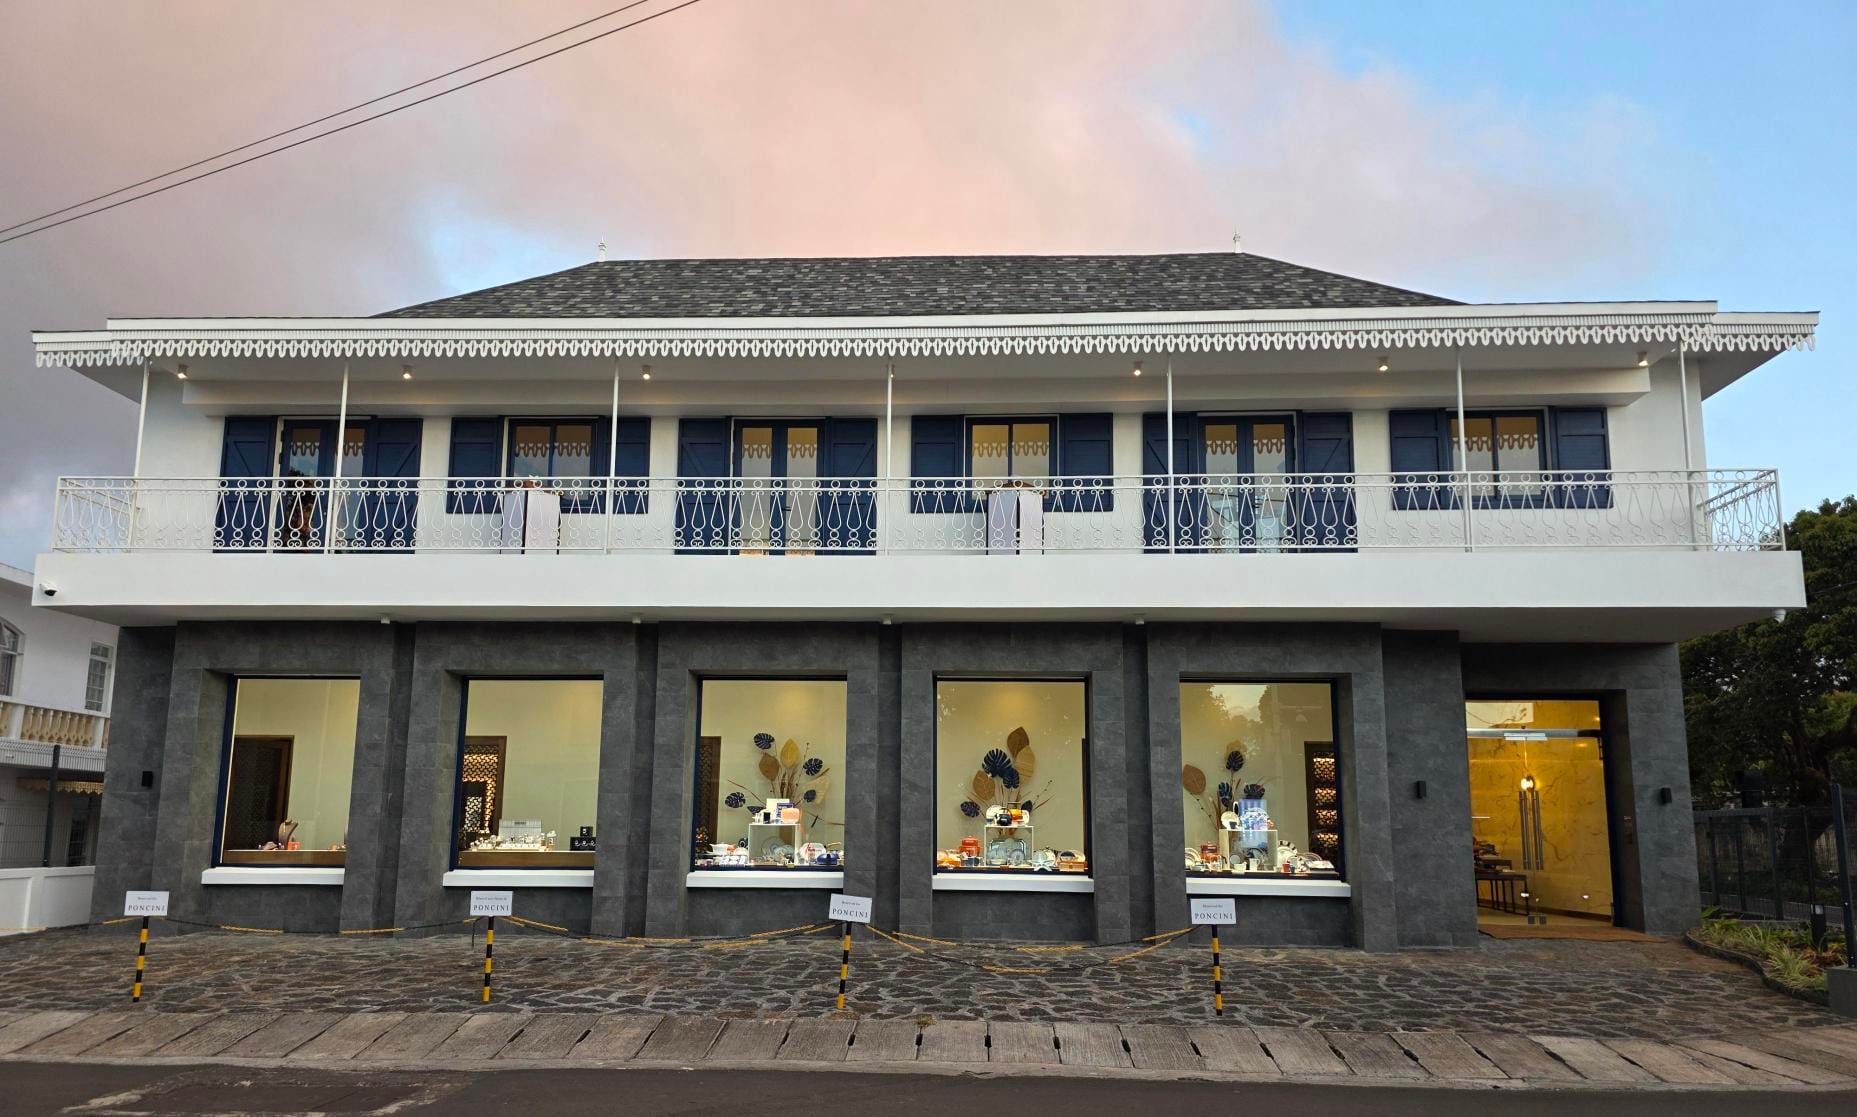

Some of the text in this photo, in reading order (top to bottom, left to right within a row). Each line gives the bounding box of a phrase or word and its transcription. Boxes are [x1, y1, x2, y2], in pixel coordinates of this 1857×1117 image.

[128, 904, 165, 912] PONCINI
[832, 908, 868, 918] PONCINI
[1195, 912, 1233, 920] PONCINI
